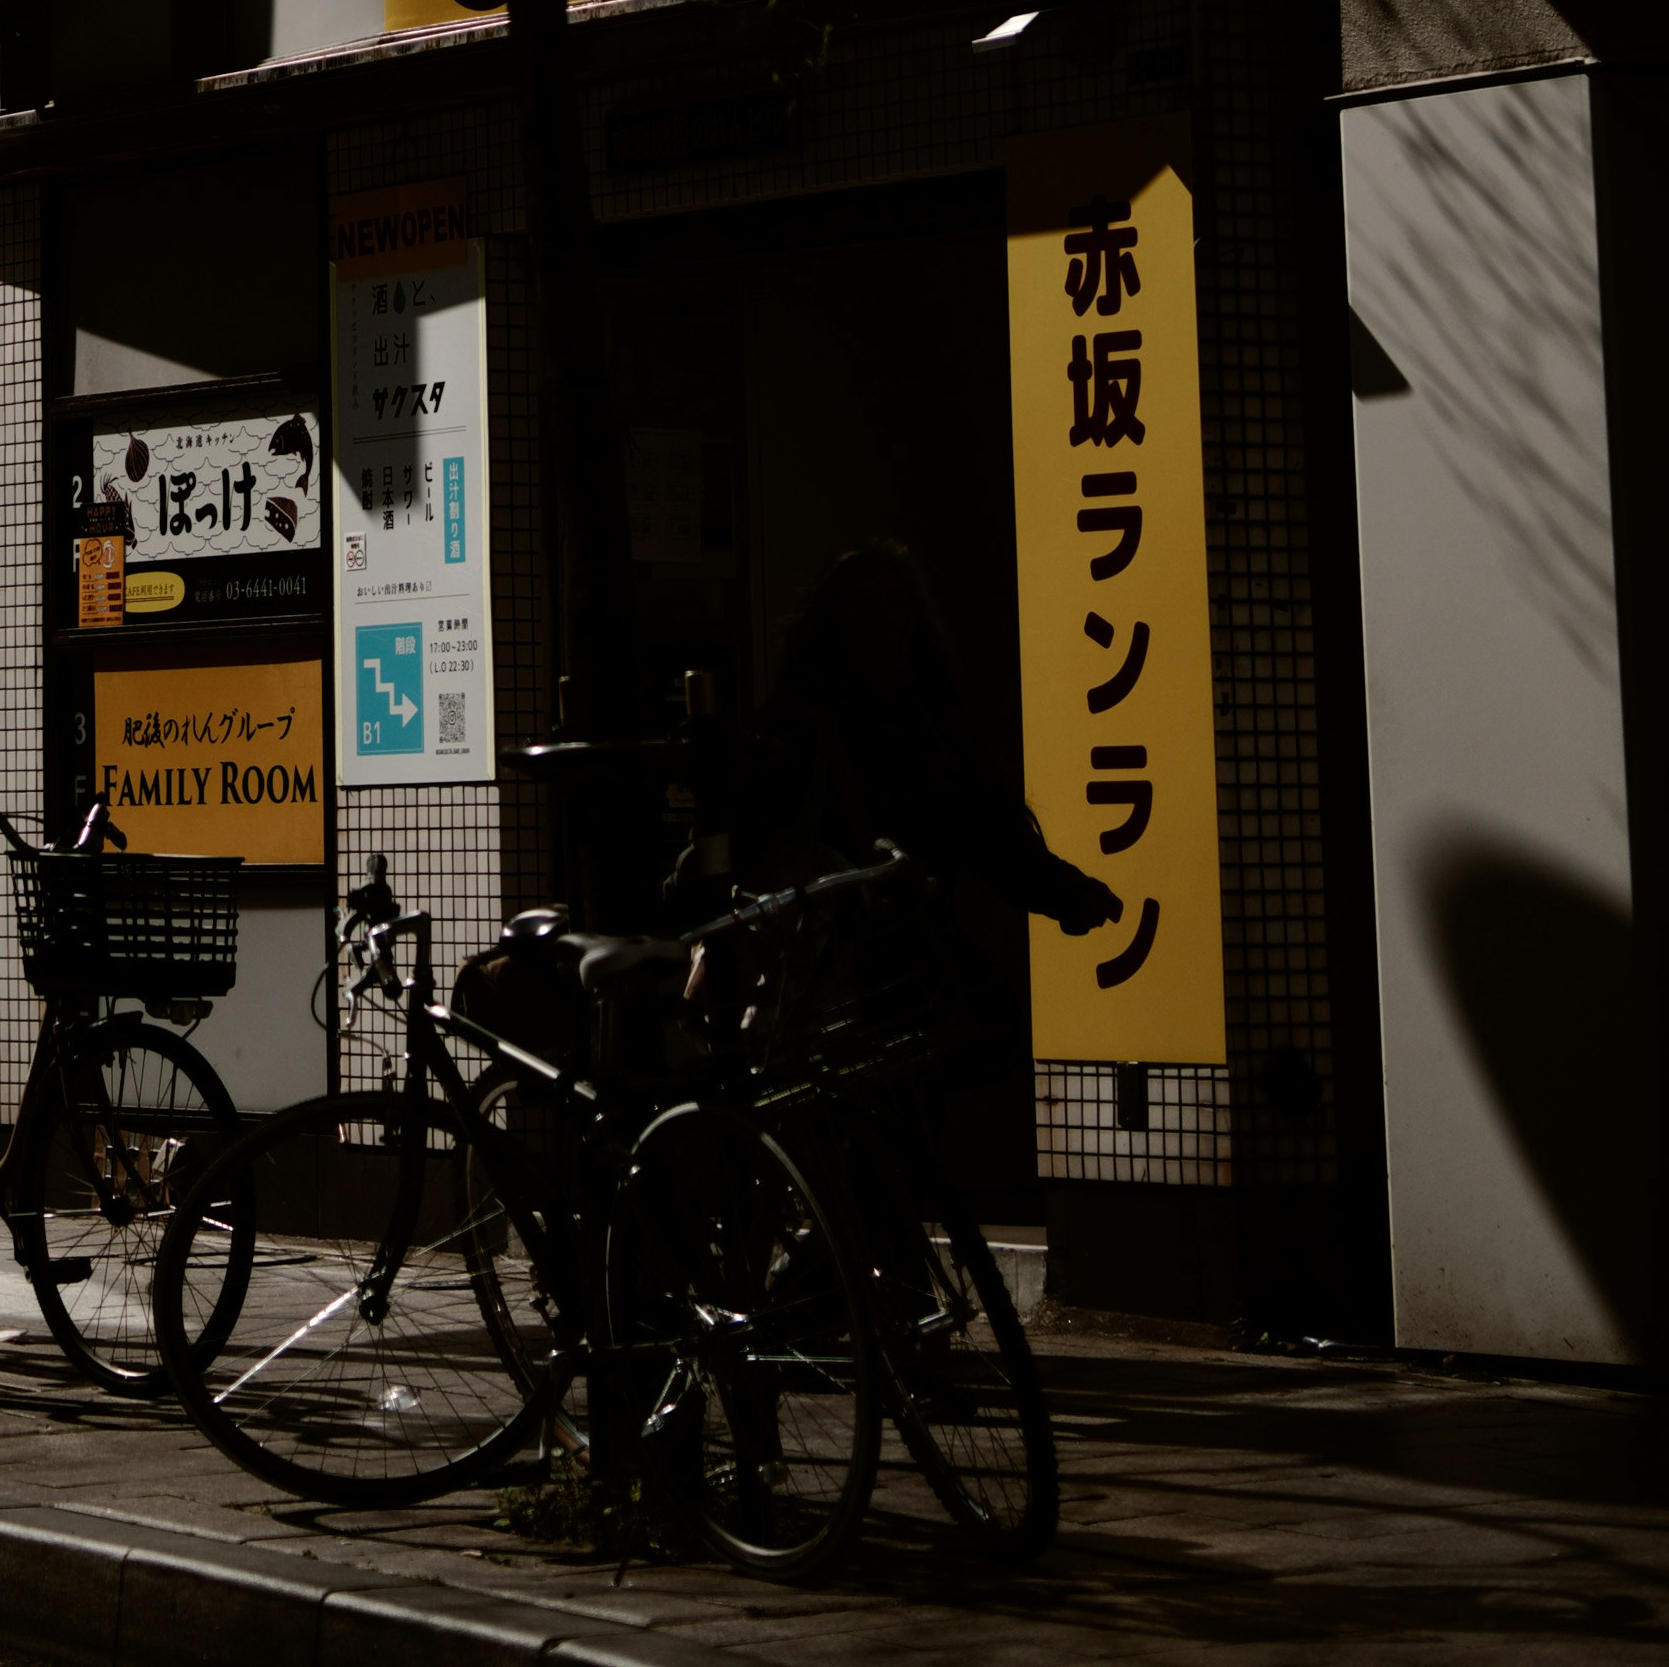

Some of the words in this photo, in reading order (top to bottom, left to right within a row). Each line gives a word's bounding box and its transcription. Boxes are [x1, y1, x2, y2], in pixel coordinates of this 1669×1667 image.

[374, 333, 410, 366] 出汁
[373, 382, 445, 419] サクスタ
[176, 433, 235, 449] 北海道キッチン
[159, 462, 256, 535] ぽっけ
[361, 468, 373, 510] 焼酎
[383, 466, 394, 530] 日本酒
[404, 466, 413, 525] サワー
[425, 462, 433, 521] ビール
[449, 461, 461, 559] 出汁割り酒
[226, 575, 307, 600] 03-6441-0041
[1064, 194, 1160, 989] 赤坂ランラン
[395, 636, 416, 655] 階段
[438, 618, 468, 632] 営業時間
[363, 721, 380, 744] B1
[102, 765, 212, 806] FAMILY
[220, 761, 318, 805] ROOM
